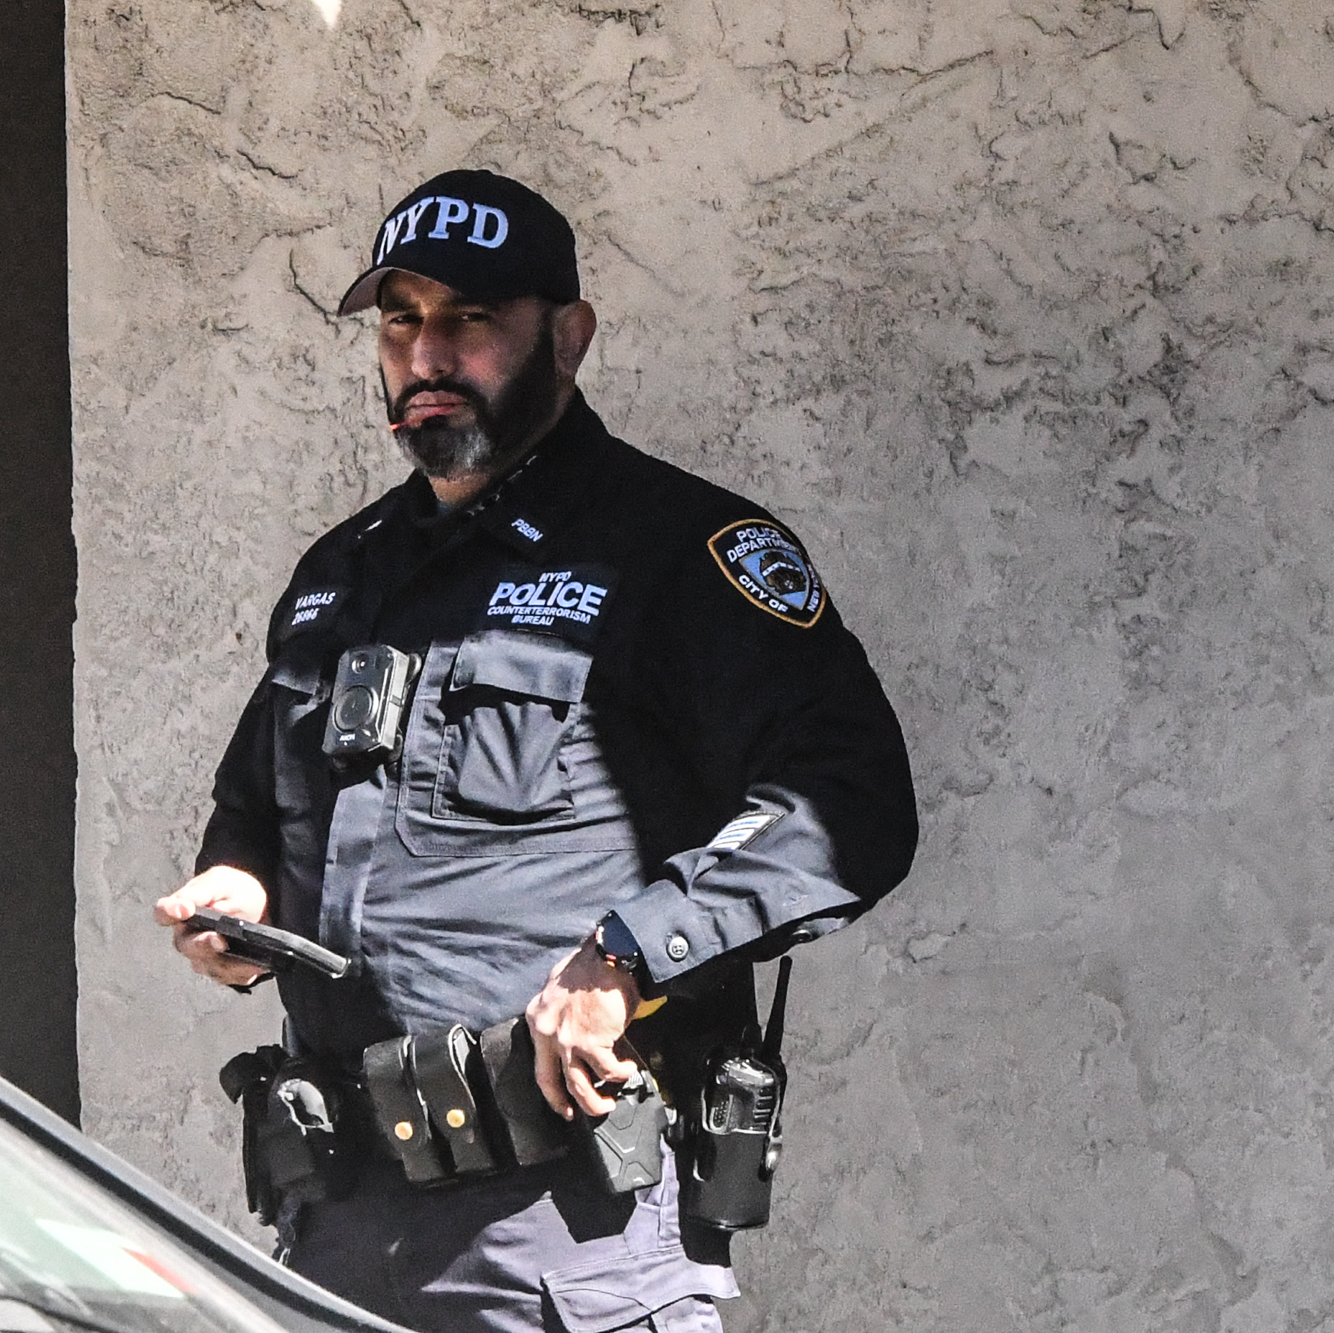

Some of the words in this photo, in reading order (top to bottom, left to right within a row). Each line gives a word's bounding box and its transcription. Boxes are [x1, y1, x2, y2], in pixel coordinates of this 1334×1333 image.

[376, 195, 509, 266] NYPD
[538, 571, 572, 583] NYPD
[295, 592, 336, 610] VARGAS
[488, 581, 608, 617] POLICE
[738, 574, 769, 600] CITY
[768, 598, 789, 613] OF
[487, 606, 591, 625] COUNTERTERRORISM
[511, 615, 555, 626] BUREAU
